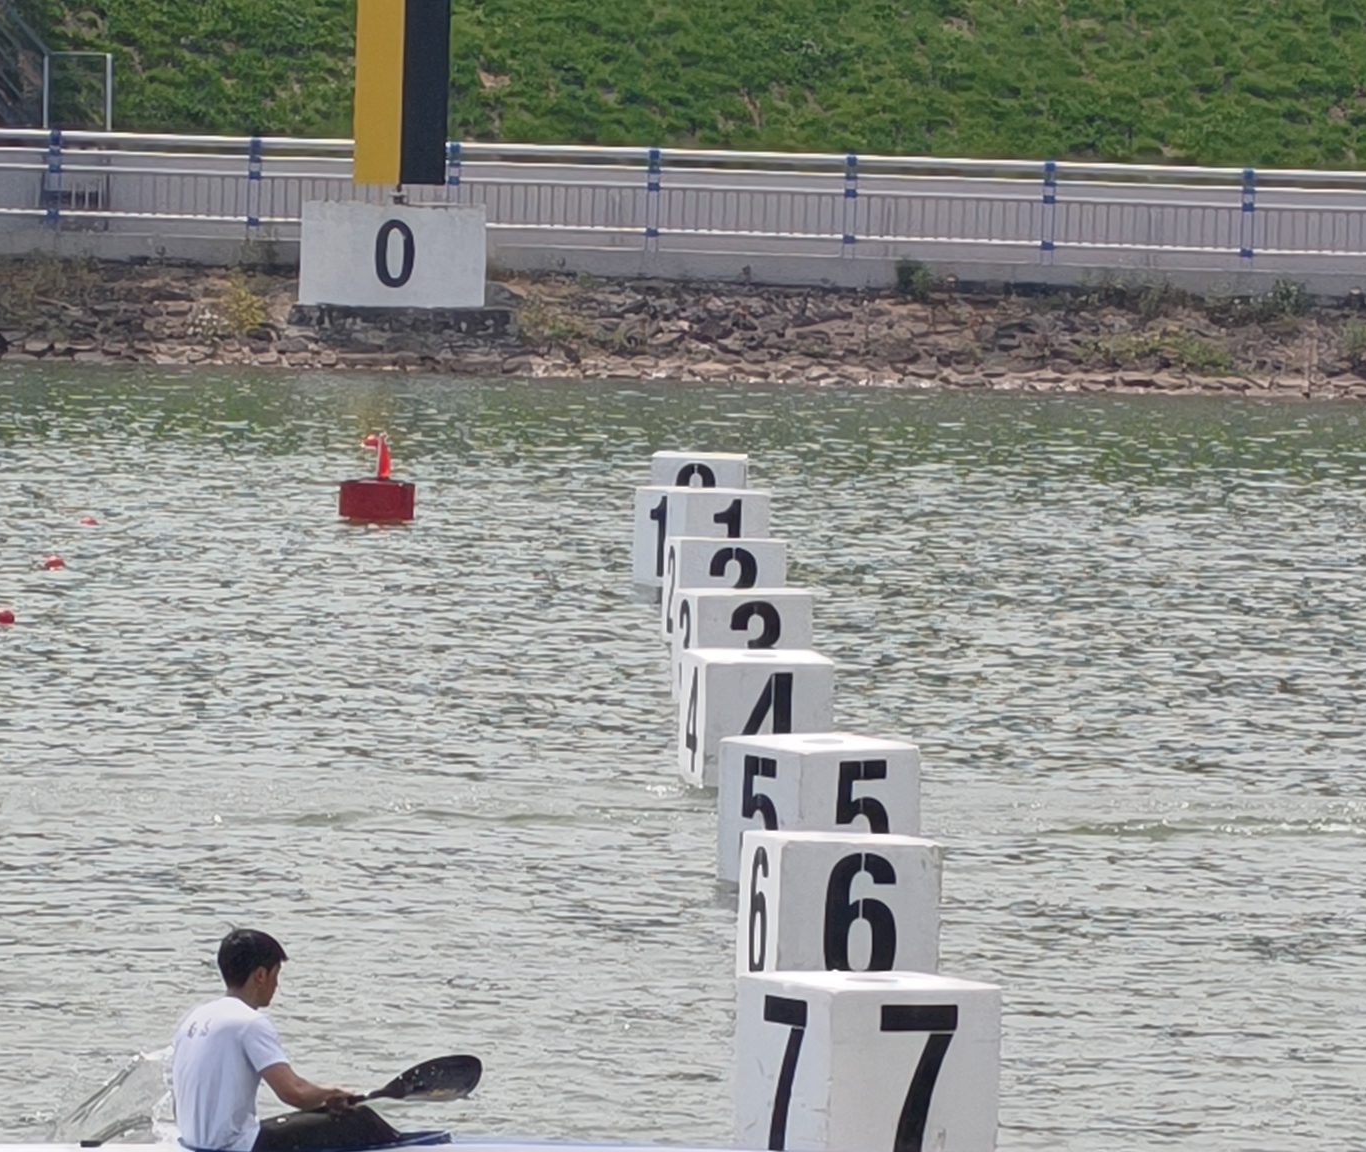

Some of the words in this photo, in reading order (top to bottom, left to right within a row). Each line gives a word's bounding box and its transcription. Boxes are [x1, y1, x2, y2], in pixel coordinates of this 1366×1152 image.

[375, 219, 415, 287] 0
[650, 495, 668, 577] 1
[666, 545, 677, 635] 2
[686, 666, 699, 773] 4
[741, 672, 793, 734] 4
[741, 755, 779, 831] 5
[836, 760, 890, 834] 5
[749, 846, 769, 972] 6
[823, 852, 897, 972] 6
[764, 994, 808, 1151] 7
